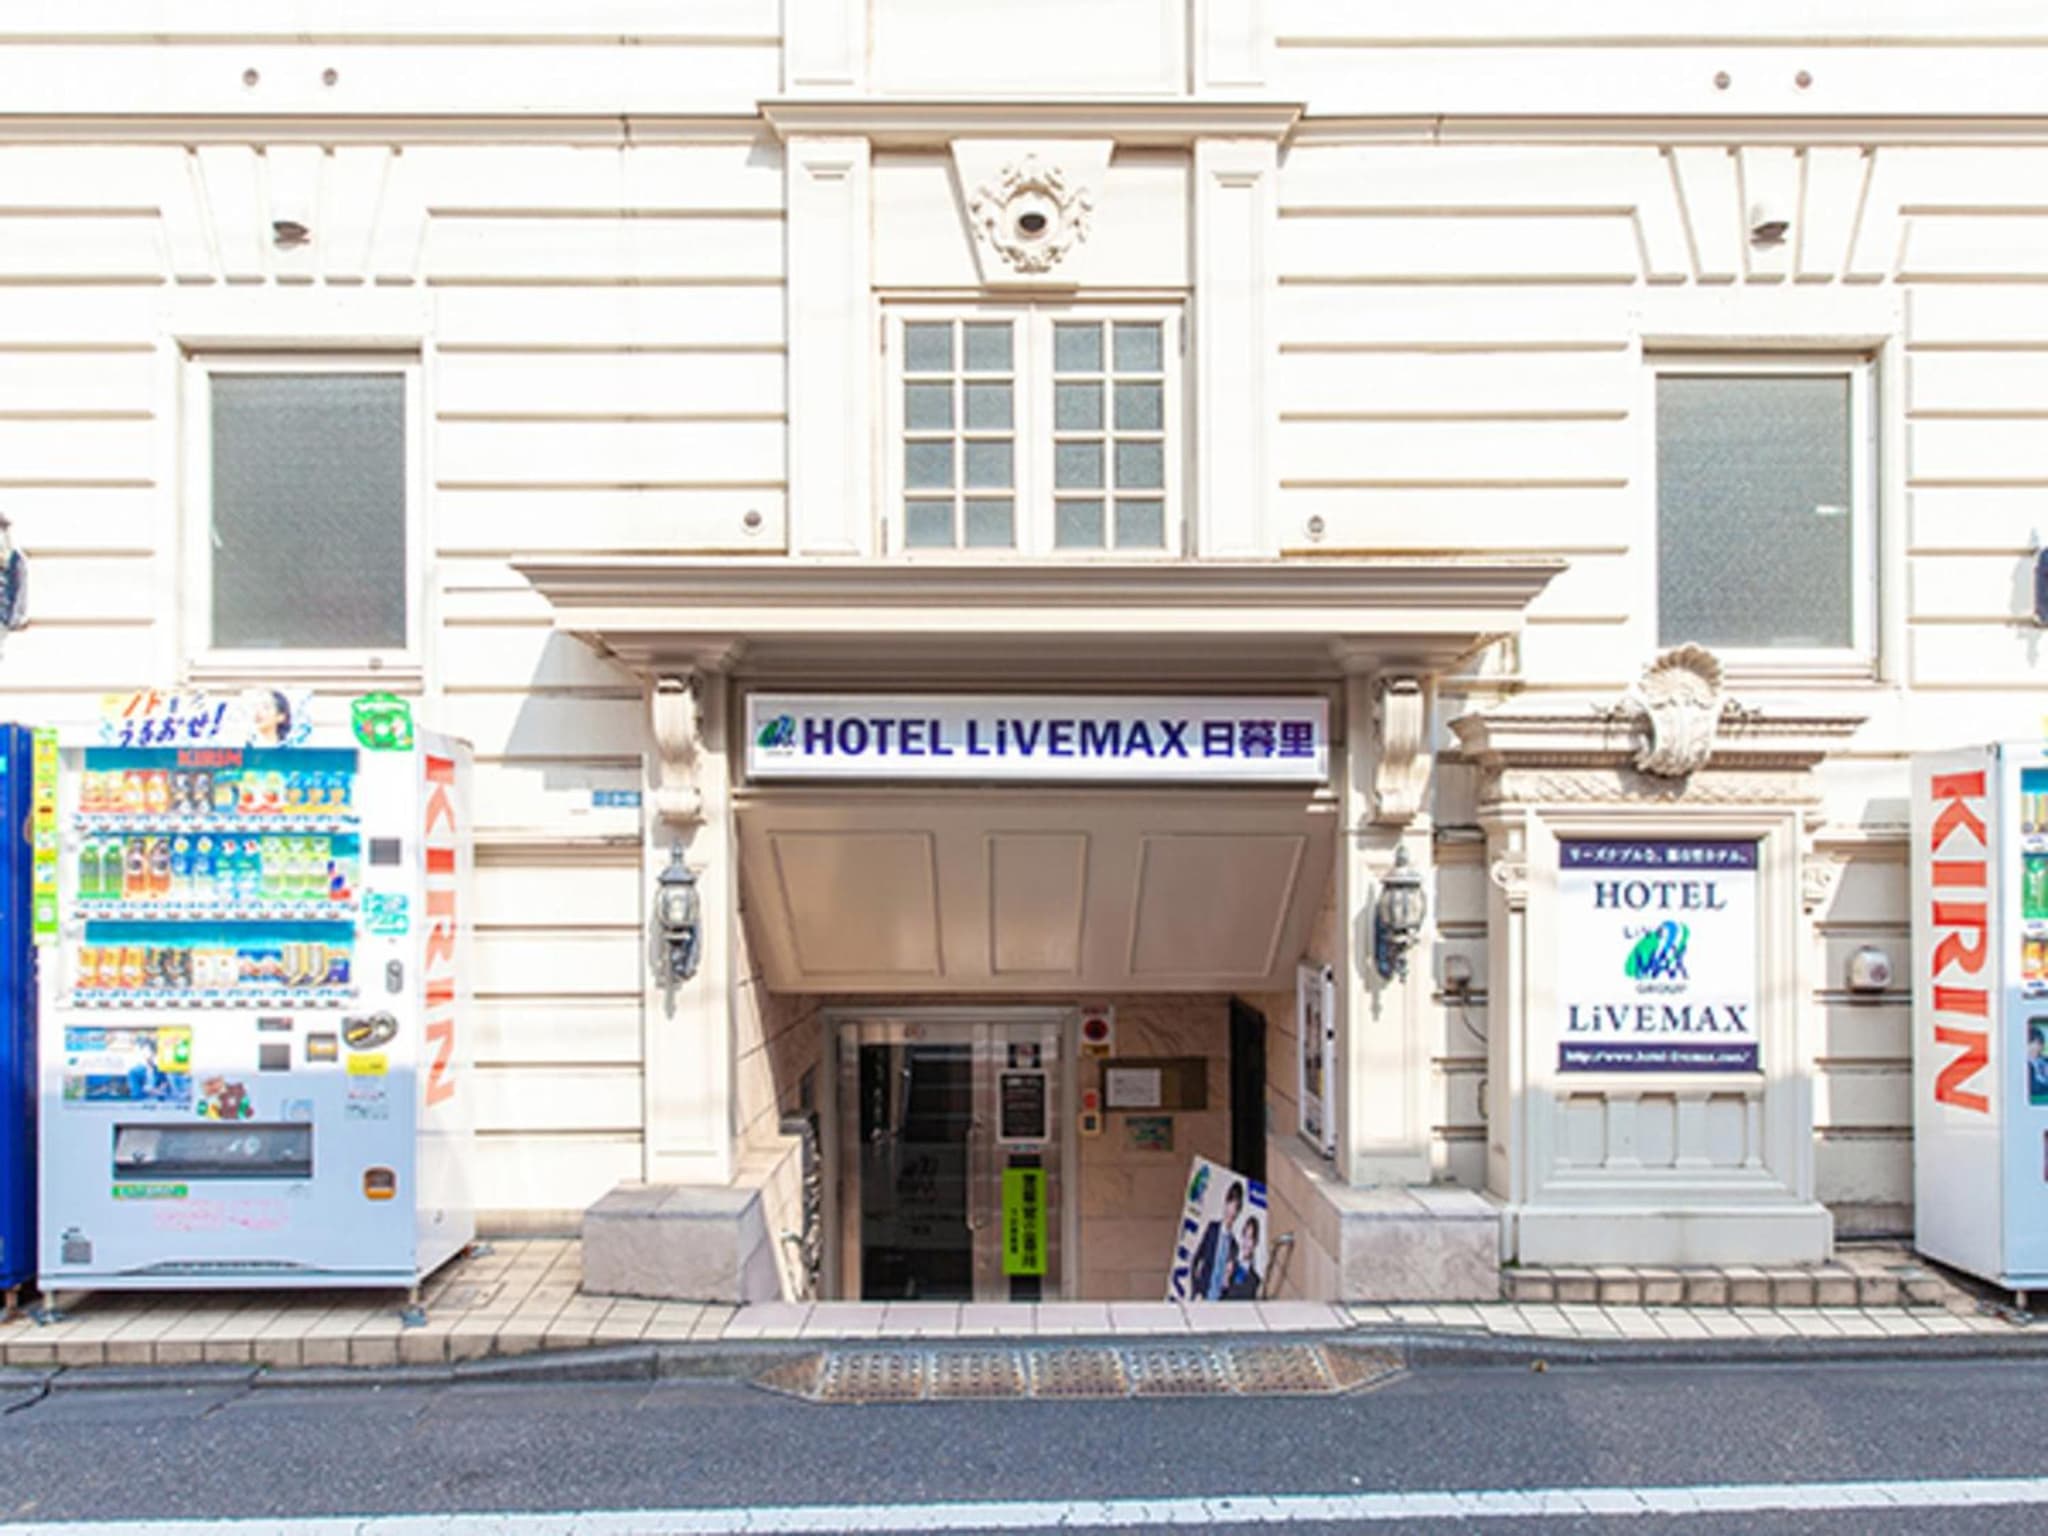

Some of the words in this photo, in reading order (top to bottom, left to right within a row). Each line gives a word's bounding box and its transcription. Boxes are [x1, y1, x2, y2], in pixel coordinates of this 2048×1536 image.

[803, 717, 953, 757] HOTEL
[966, 717, 1189, 757] LiVEMAX
[1202, 719, 1315, 758] 日暮里
[1594, 881, 1728, 909] HOTEL
[424, 754, 456, 1107] KIRIN
[1931, 769, 1990, 1114] KIRIN
[1567, 1004, 1749, 1032] LiVEMAX
